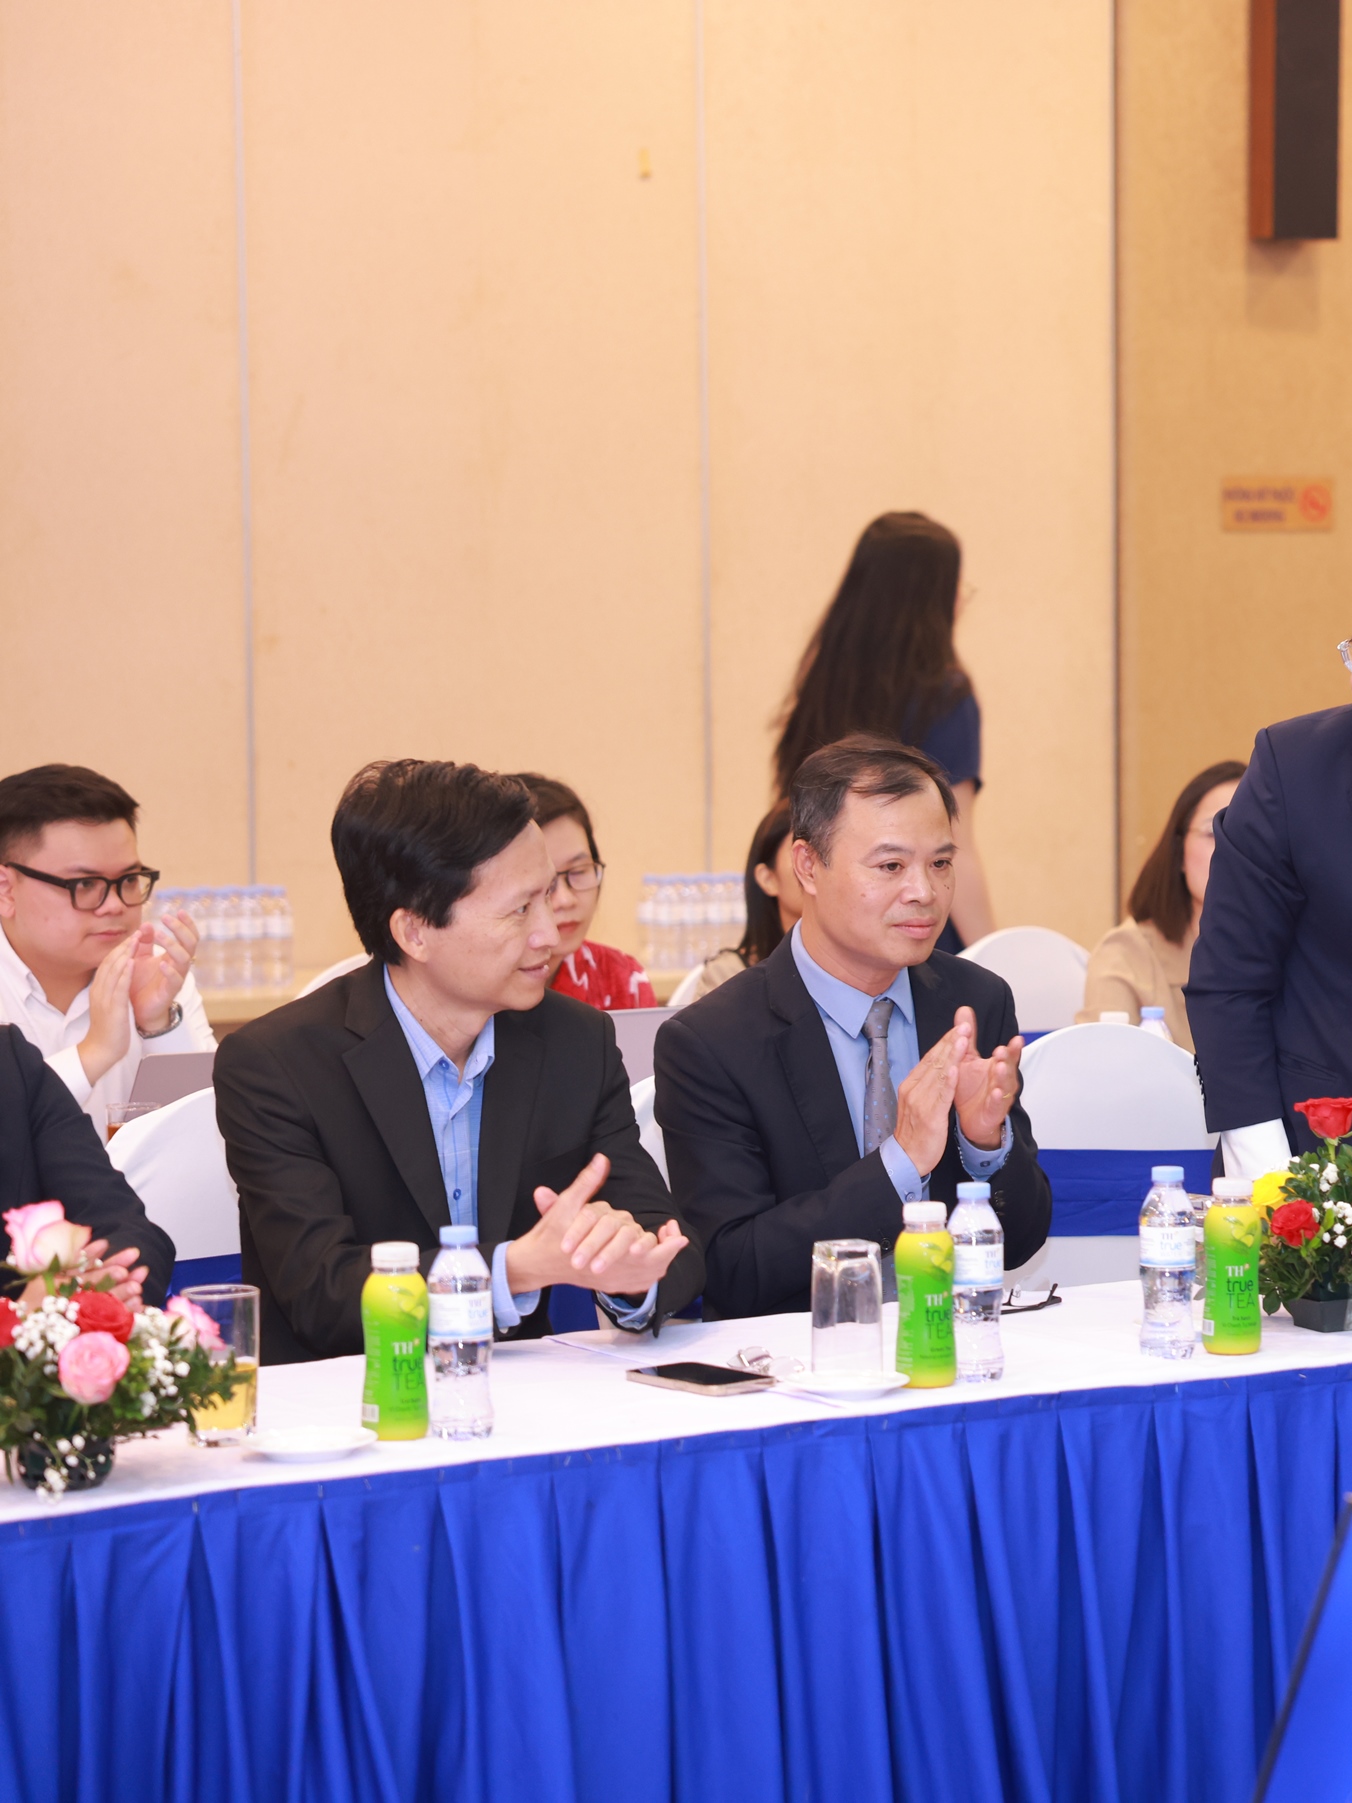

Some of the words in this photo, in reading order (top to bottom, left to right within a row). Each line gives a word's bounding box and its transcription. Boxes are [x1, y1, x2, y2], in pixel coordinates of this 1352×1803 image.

[1225, 1265, 1244, 1277] TH
[1226, 1278, 1253, 1292] true
[924, 1293, 943, 1306] TH
[1226, 1293, 1255, 1308] TEA
[925, 1308, 951, 1322] true
[925, 1322, 953, 1339] TEA
[391, 1341, 413, 1355] TH
